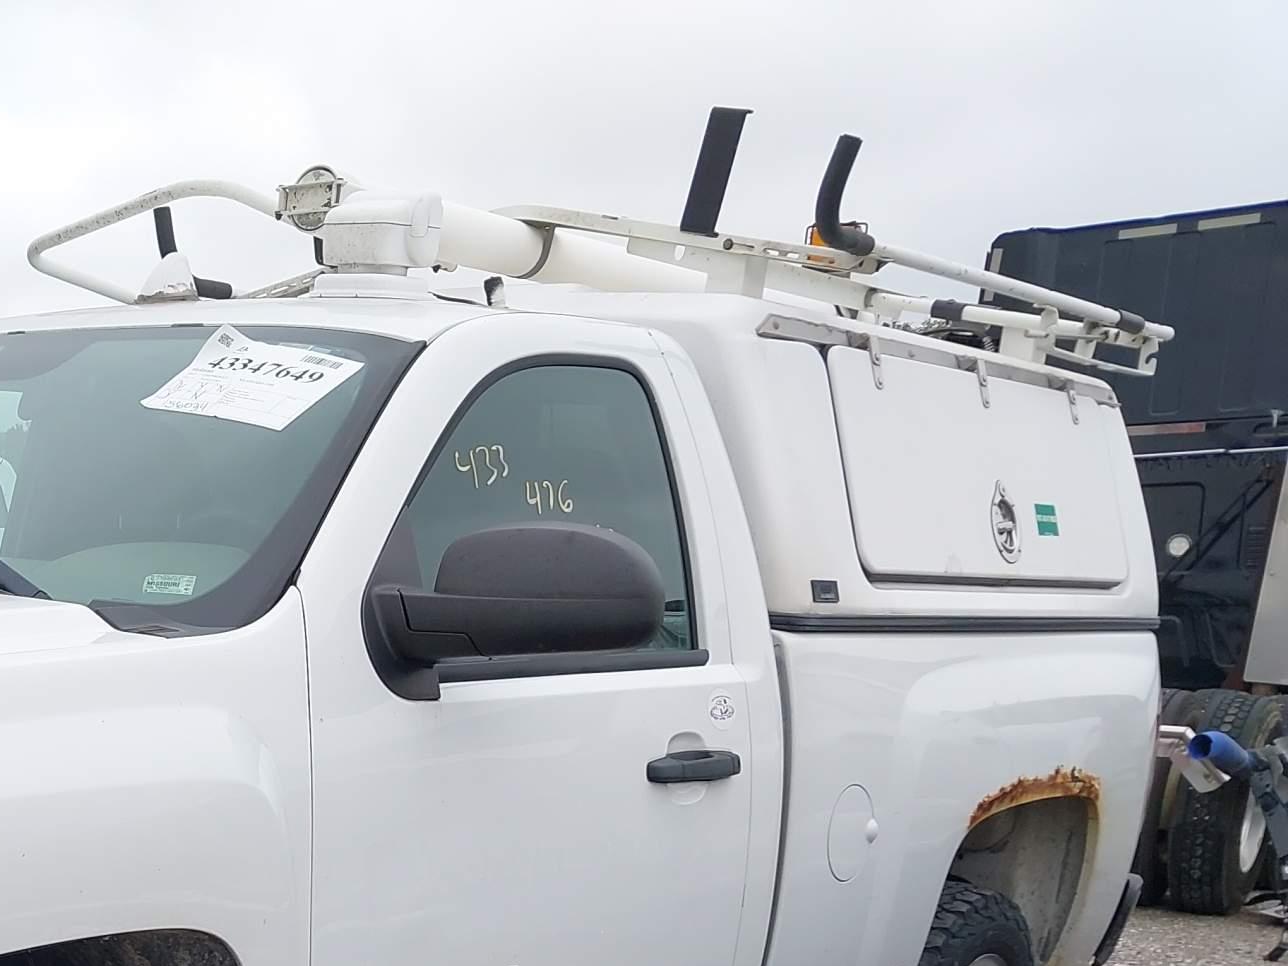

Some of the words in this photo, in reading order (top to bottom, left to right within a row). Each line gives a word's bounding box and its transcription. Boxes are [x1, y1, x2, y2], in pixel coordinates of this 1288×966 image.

[207, 355, 325, 384] 43347649
[454, 444, 509, 489] 433
[525, 479, 574, 515] 476
